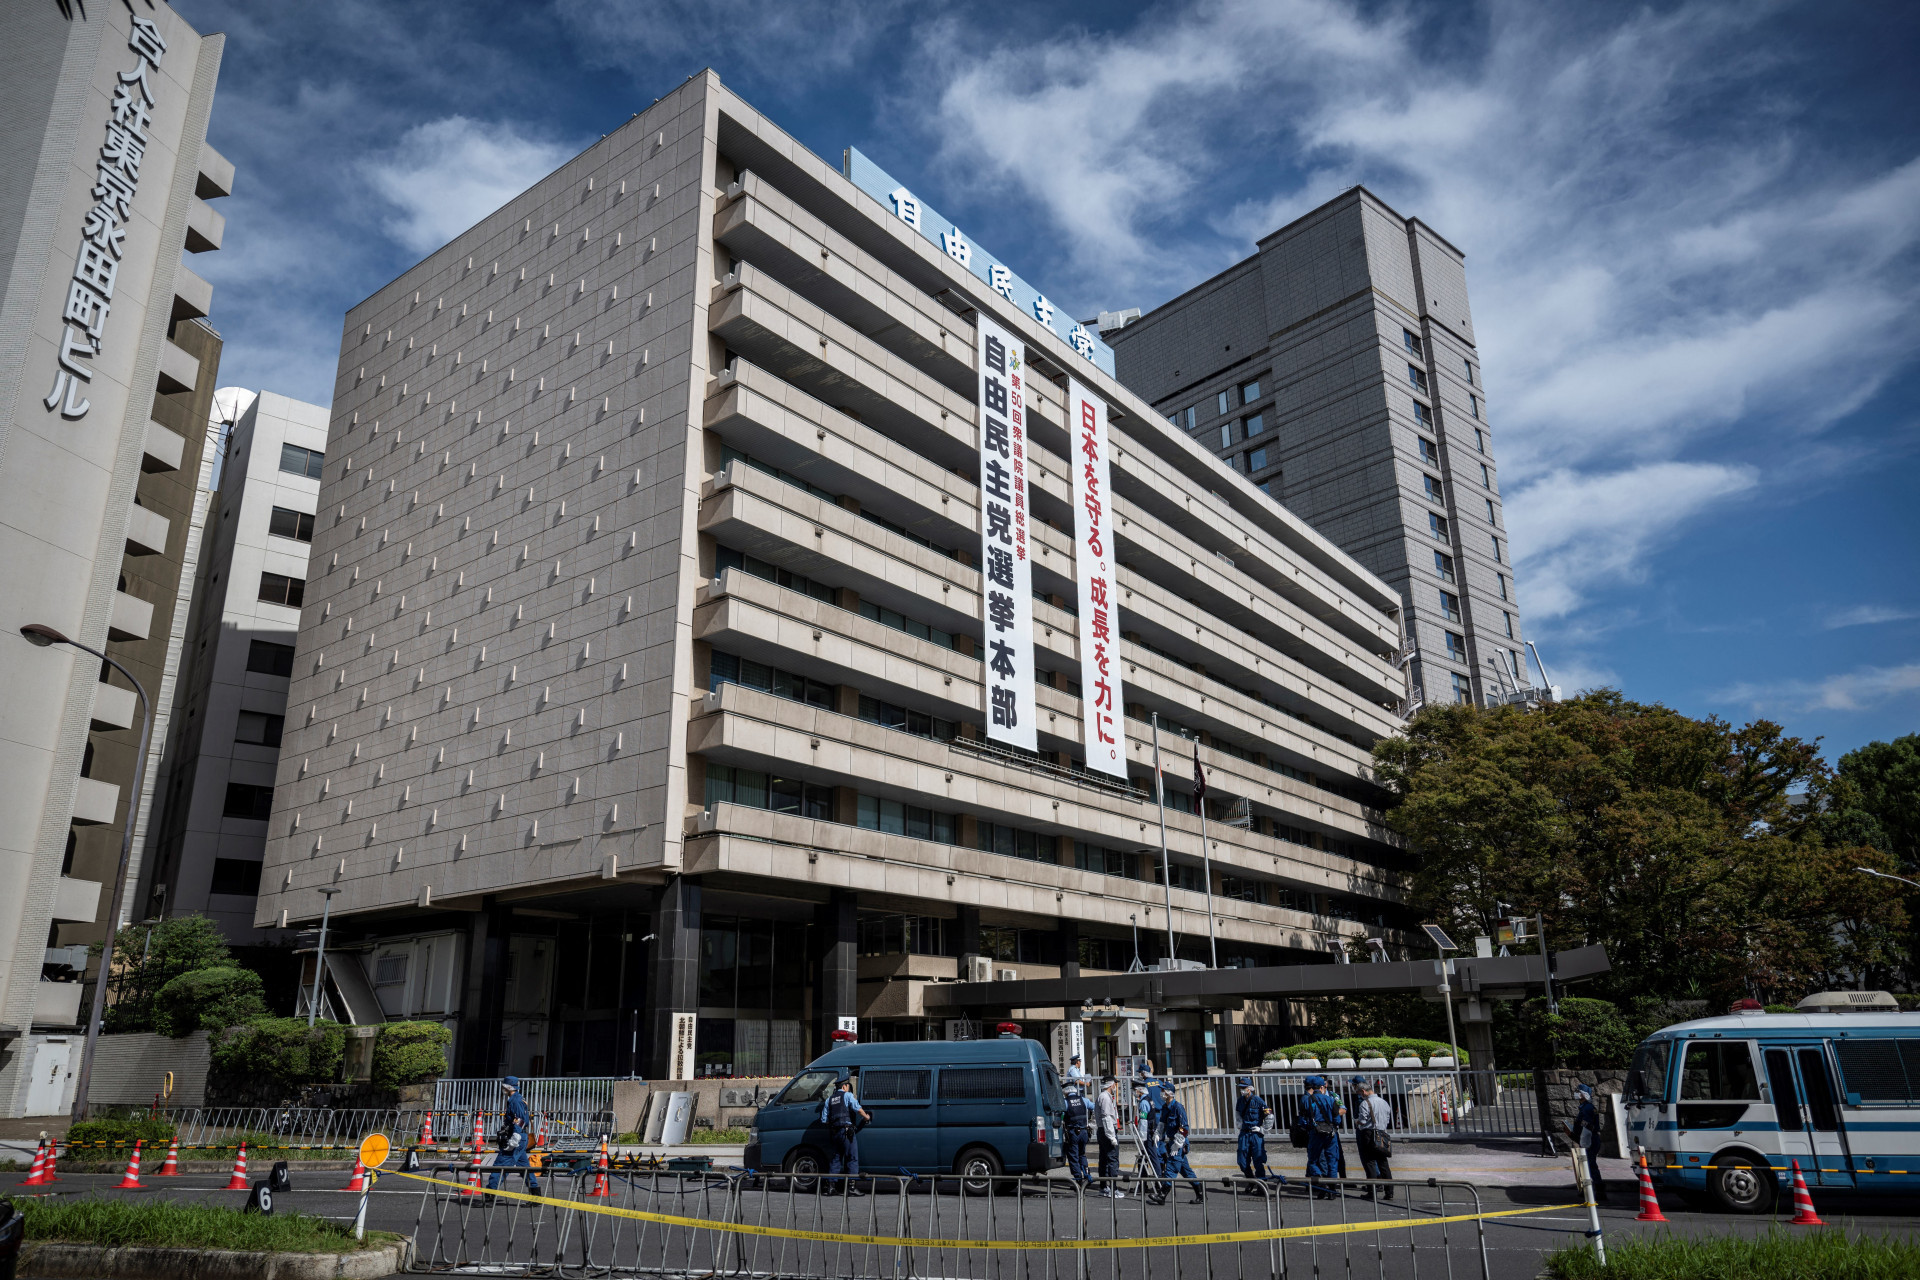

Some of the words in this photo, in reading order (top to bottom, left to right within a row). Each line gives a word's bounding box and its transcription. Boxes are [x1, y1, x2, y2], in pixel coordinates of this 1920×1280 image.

[43, 14, 168, 420] 合人社東京永田町ビル
[984, 333, 1018, 730] 自由民主党選挙本部
[1011, 373, 1026, 561] 第50回衆議院議員総選挙
[259, 1187, 272, 1211] 6
[409, 1152, 419, 1168] A
